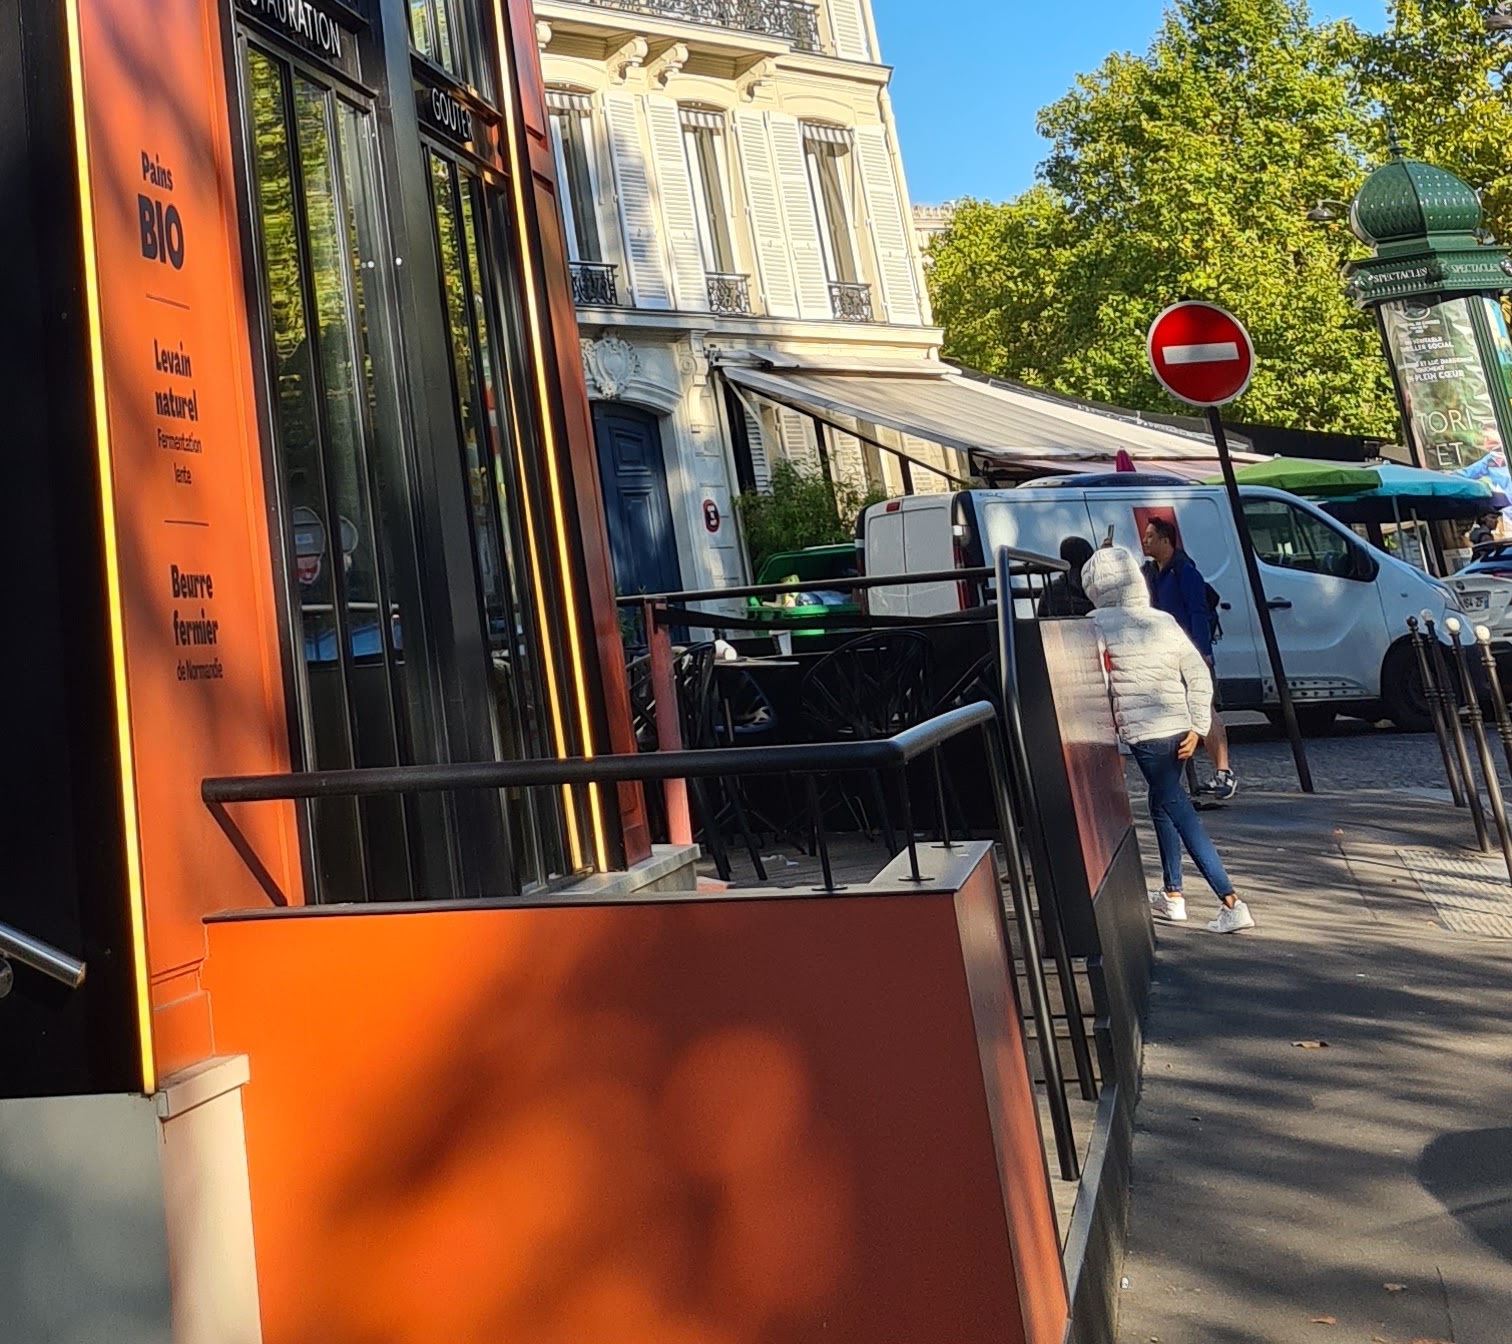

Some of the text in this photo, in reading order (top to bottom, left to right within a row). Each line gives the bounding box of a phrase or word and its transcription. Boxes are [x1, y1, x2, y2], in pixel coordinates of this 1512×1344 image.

[141, 150, 173, 191] Pains
[138, 192, 185, 270] BIO
[1372, 267, 1428, 283] SPECTACLES
[154, 338, 192, 378] Levain
[1428, 341, 1454, 350] SOCIAL
[155, 386, 199, 422] naturel
[1416, 408, 1474, 435] TORI
[1436, 441, 1464, 466] ET
[170, 565, 213, 599] Beurre
[173, 609, 218, 645] fermier
